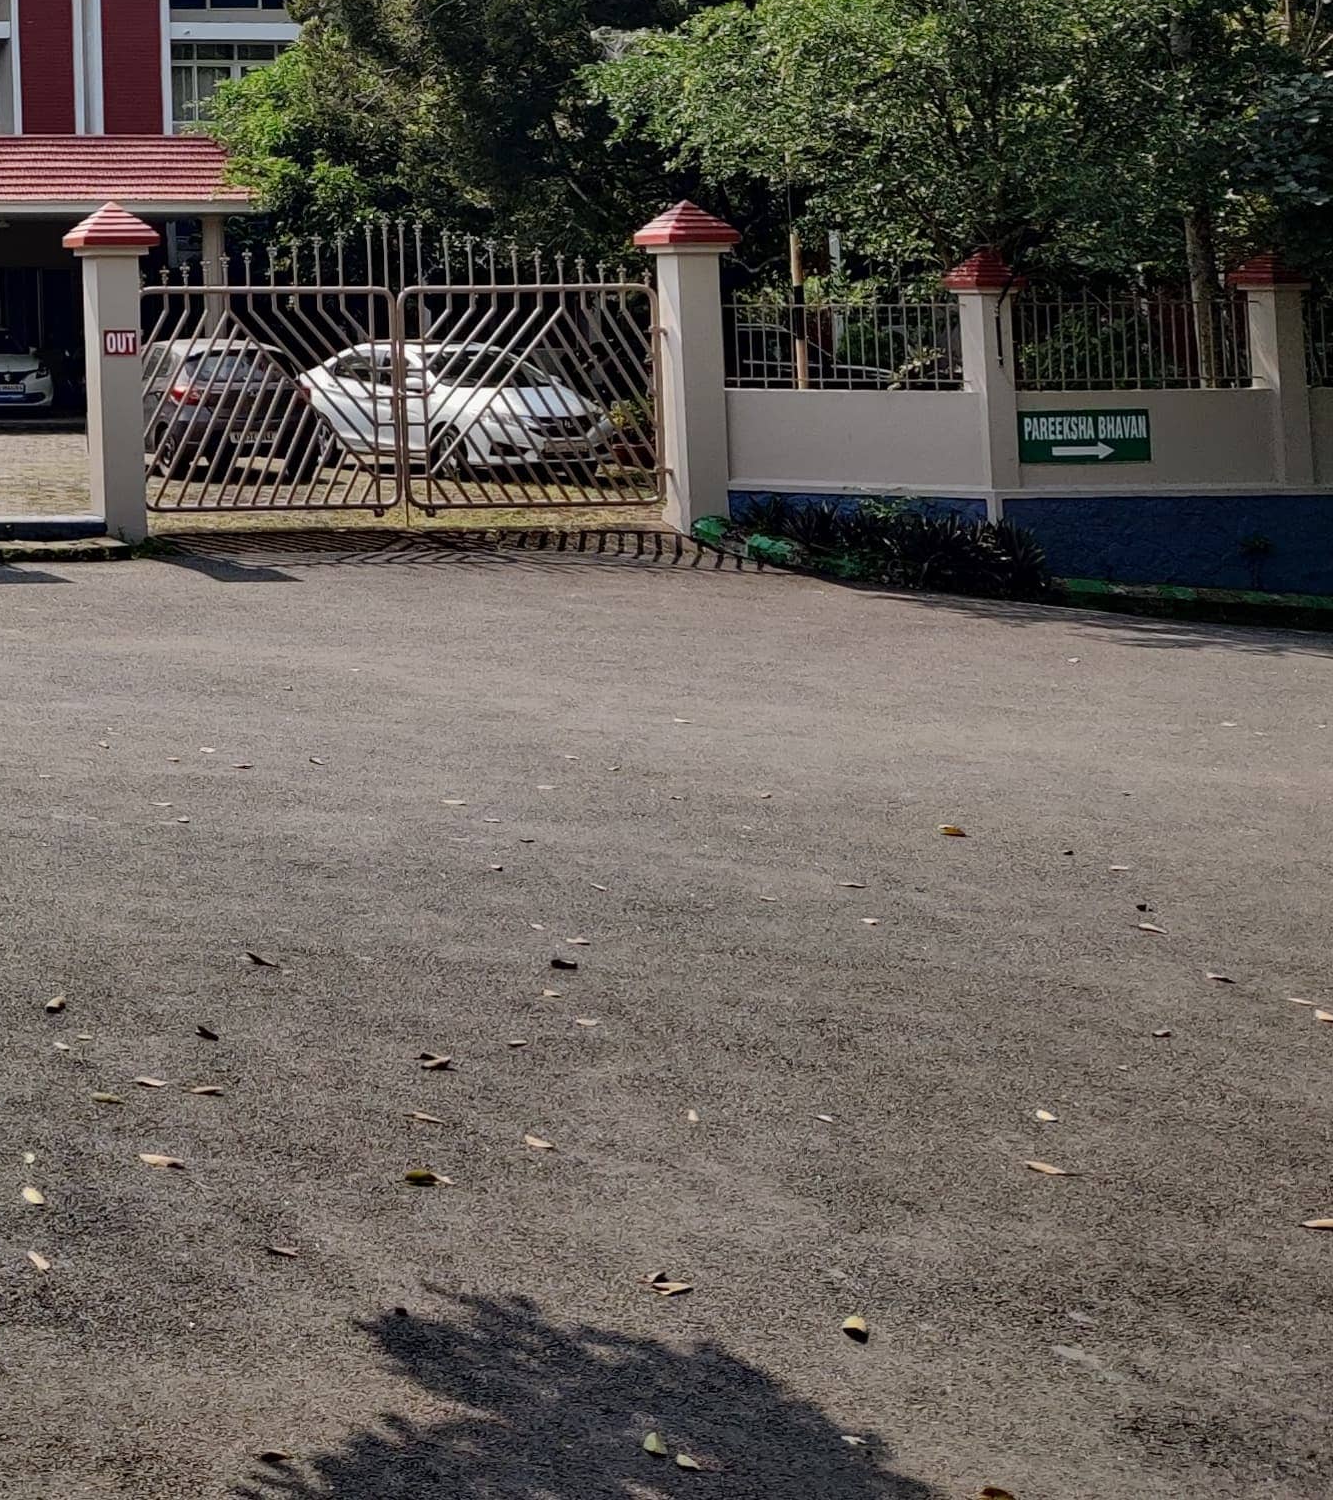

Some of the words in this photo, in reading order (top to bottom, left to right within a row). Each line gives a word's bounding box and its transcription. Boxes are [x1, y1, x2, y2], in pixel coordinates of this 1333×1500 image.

[107, 332, 136, 353] OUT
[1024, 417, 1095, 440] PAREEKSHA
[1098, 415, 1147, 439] BHAVAN
